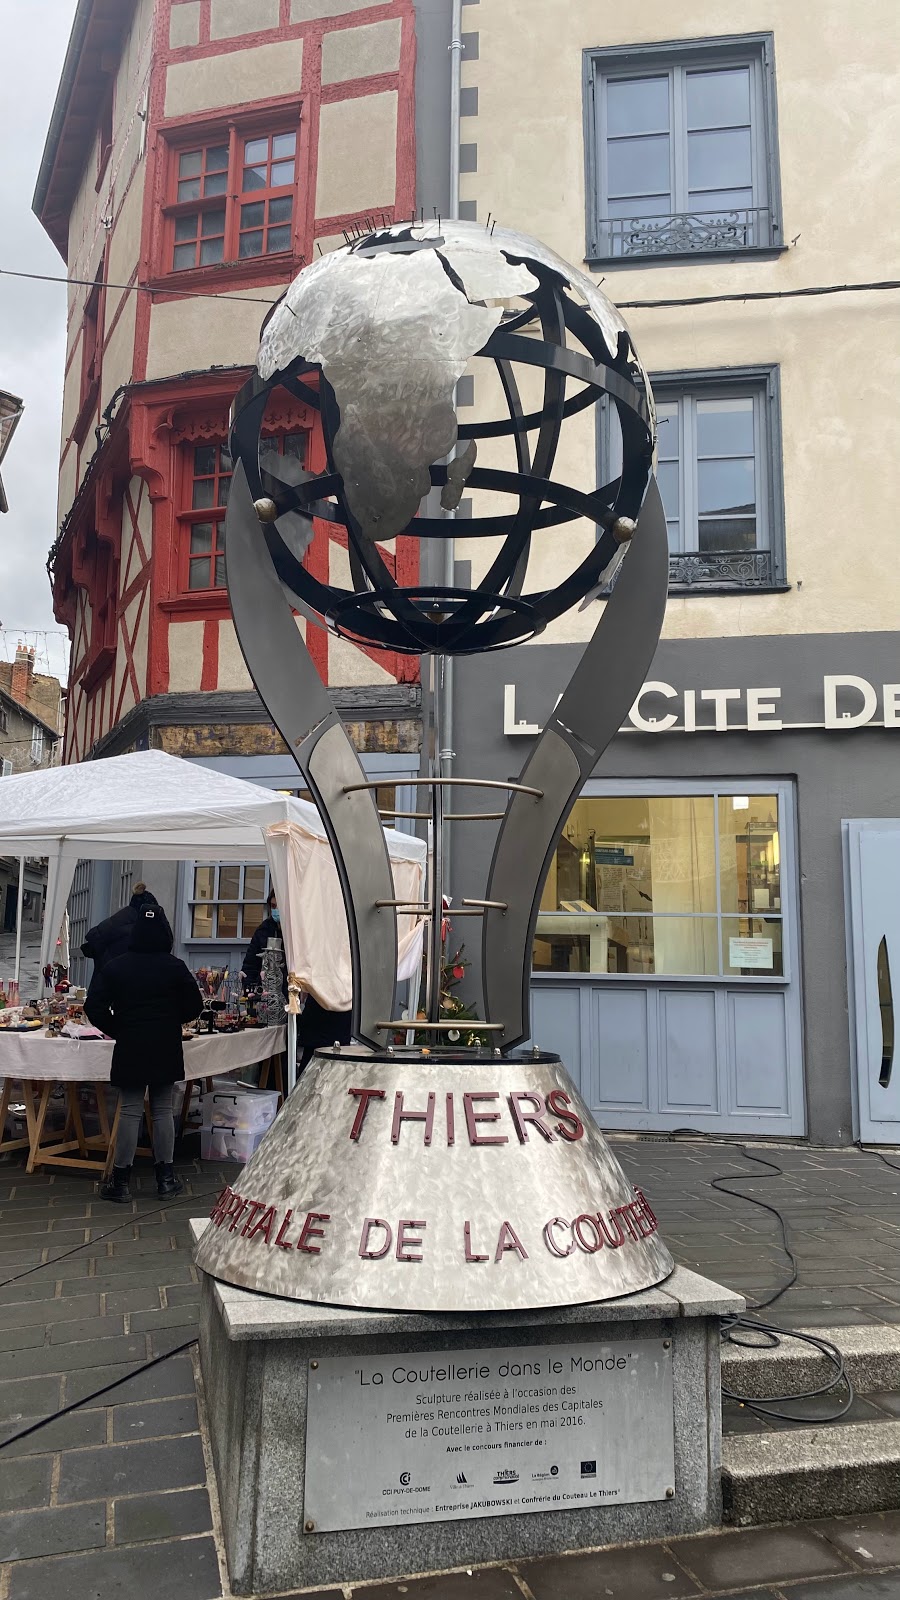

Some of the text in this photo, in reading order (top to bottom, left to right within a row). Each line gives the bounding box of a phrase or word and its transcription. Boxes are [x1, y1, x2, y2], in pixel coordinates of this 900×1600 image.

[628, 681, 783, 732] CITE
[348, 1088, 584, 1146] THIERS
[358, 1217, 427, 1261] DE
[464, 1220, 529, 1262] LA
[355, 1353, 632, 1386] "La Coutellerie dans le Monde"
[415, 1385, 576, 1406] Sculpture réalisée à l'occasion des
[386, 1399, 604, 1423] Premières Rencontres Mondiales des Capitales
[405, 1415, 586, 1438] de la Coutellerie à Thiers en mai 2016.
[472, 1443, 502, 1451] concours
[504, 1441, 533, 1449] financier
[365, 1509, 399, 1519] Réalisation
[400, 1507, 430, 1515] technique
[435, 1503, 470, 1512] Entreprise
[470, 1498, 513, 1510] JAKUBOWSKI
[521, 1495, 551, 1504] Confrérie
[562, 1492, 588, 1500] Couteau
